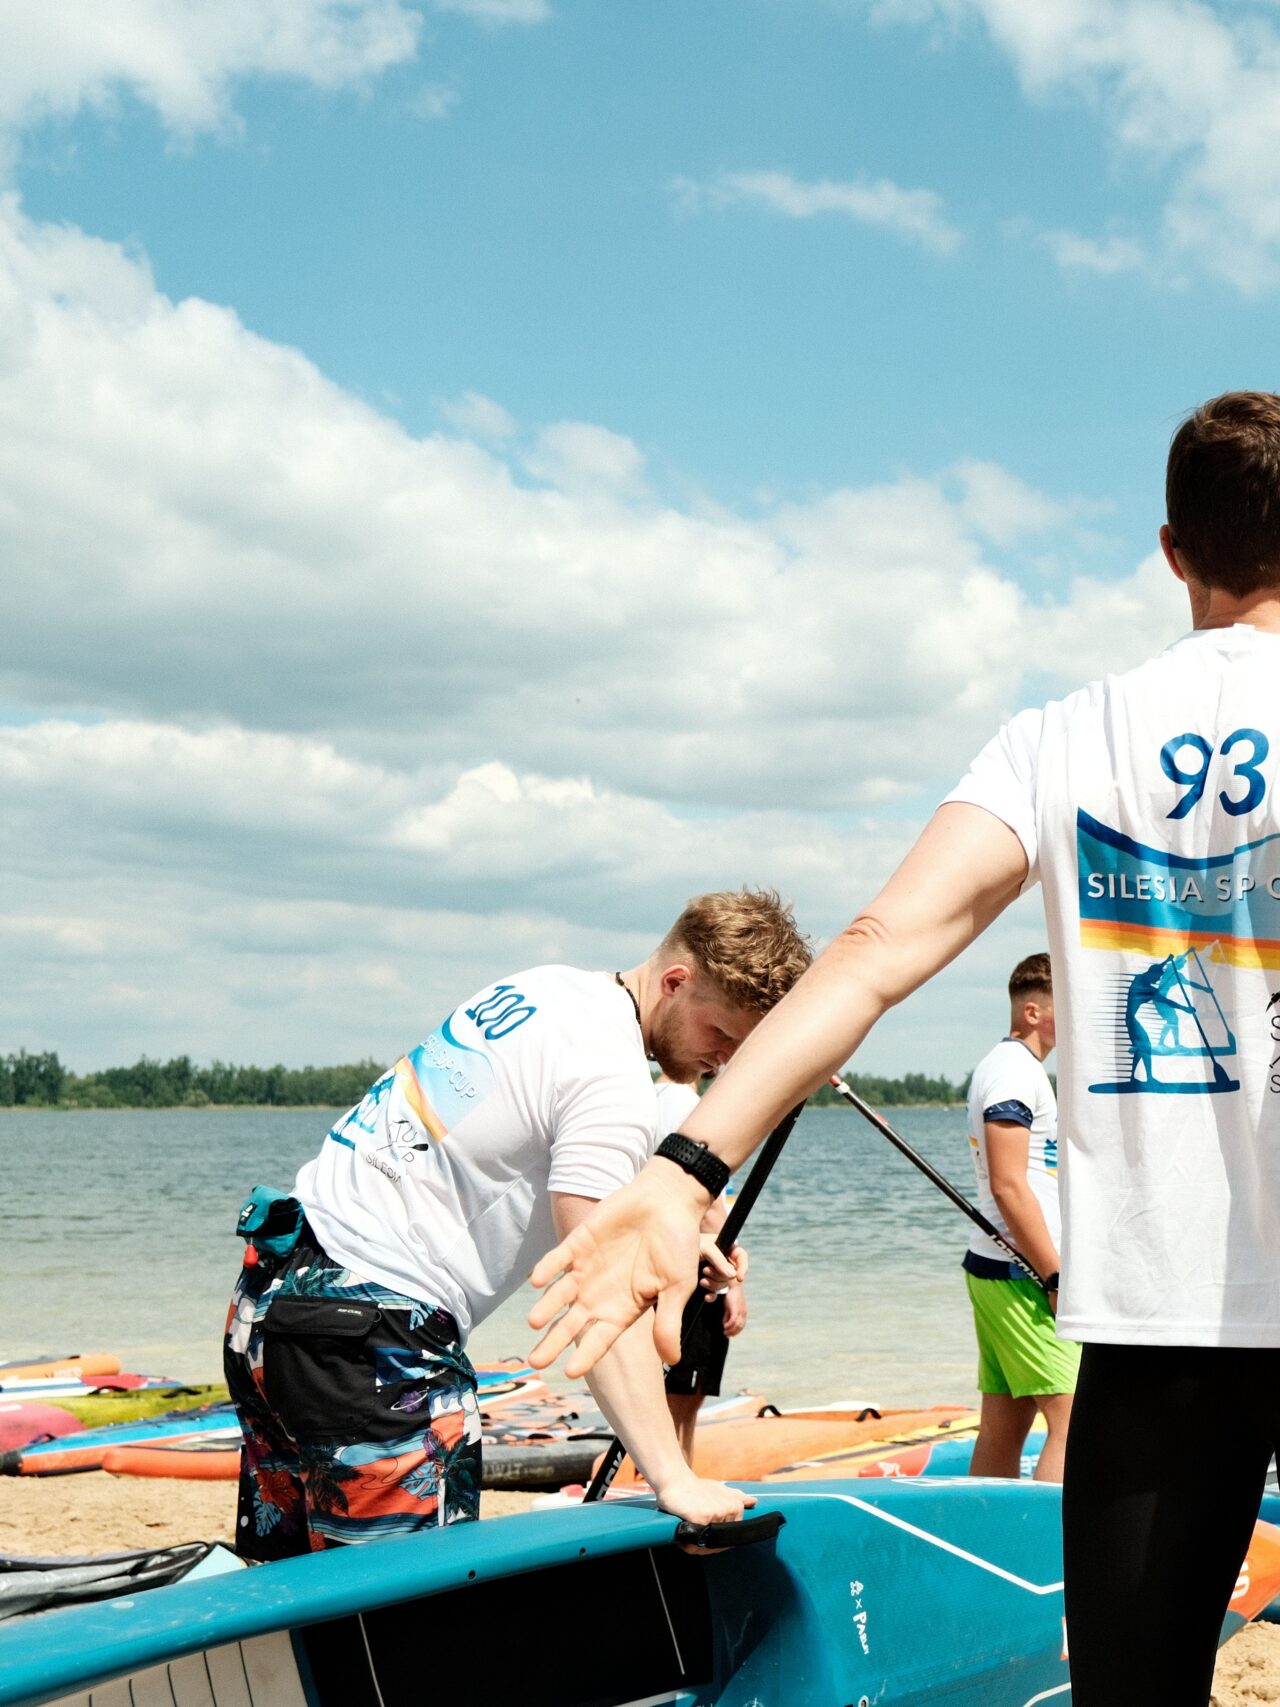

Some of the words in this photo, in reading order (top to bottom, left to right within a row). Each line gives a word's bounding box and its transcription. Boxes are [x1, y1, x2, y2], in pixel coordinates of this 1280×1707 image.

[1160, 728, 1269, 819] 93
[1087, 873, 1204, 902] SILESIA
[465, 985, 537, 1040] 100
[448, 1071, 477, 1099] CUP
